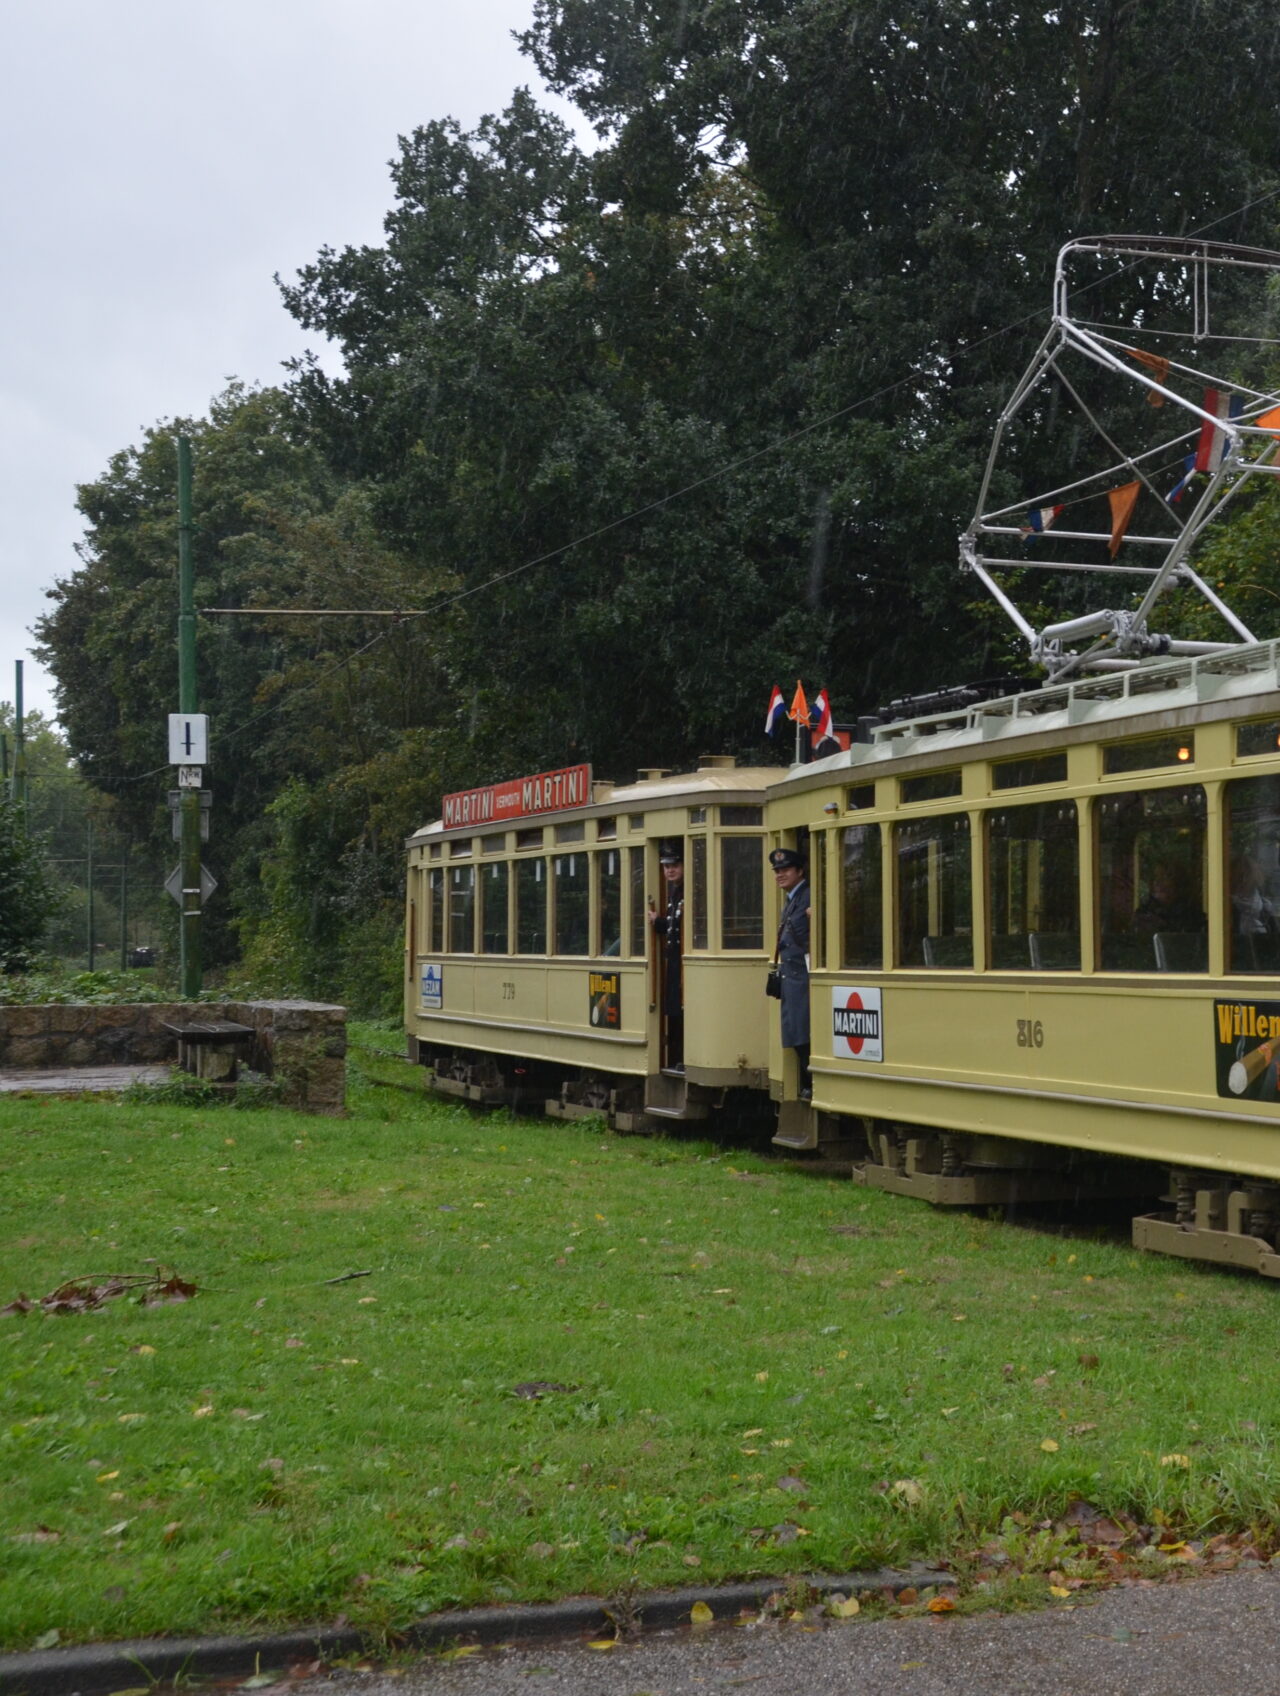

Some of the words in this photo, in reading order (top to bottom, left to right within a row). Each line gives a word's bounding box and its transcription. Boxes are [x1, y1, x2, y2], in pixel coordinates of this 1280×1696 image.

[445, 790, 494, 826] MARTINI
[522, 770, 584, 812] MARTINI
[834, 1011, 878, 1036] MARTINI
[1016, 1019, 1044, 1048] 816
